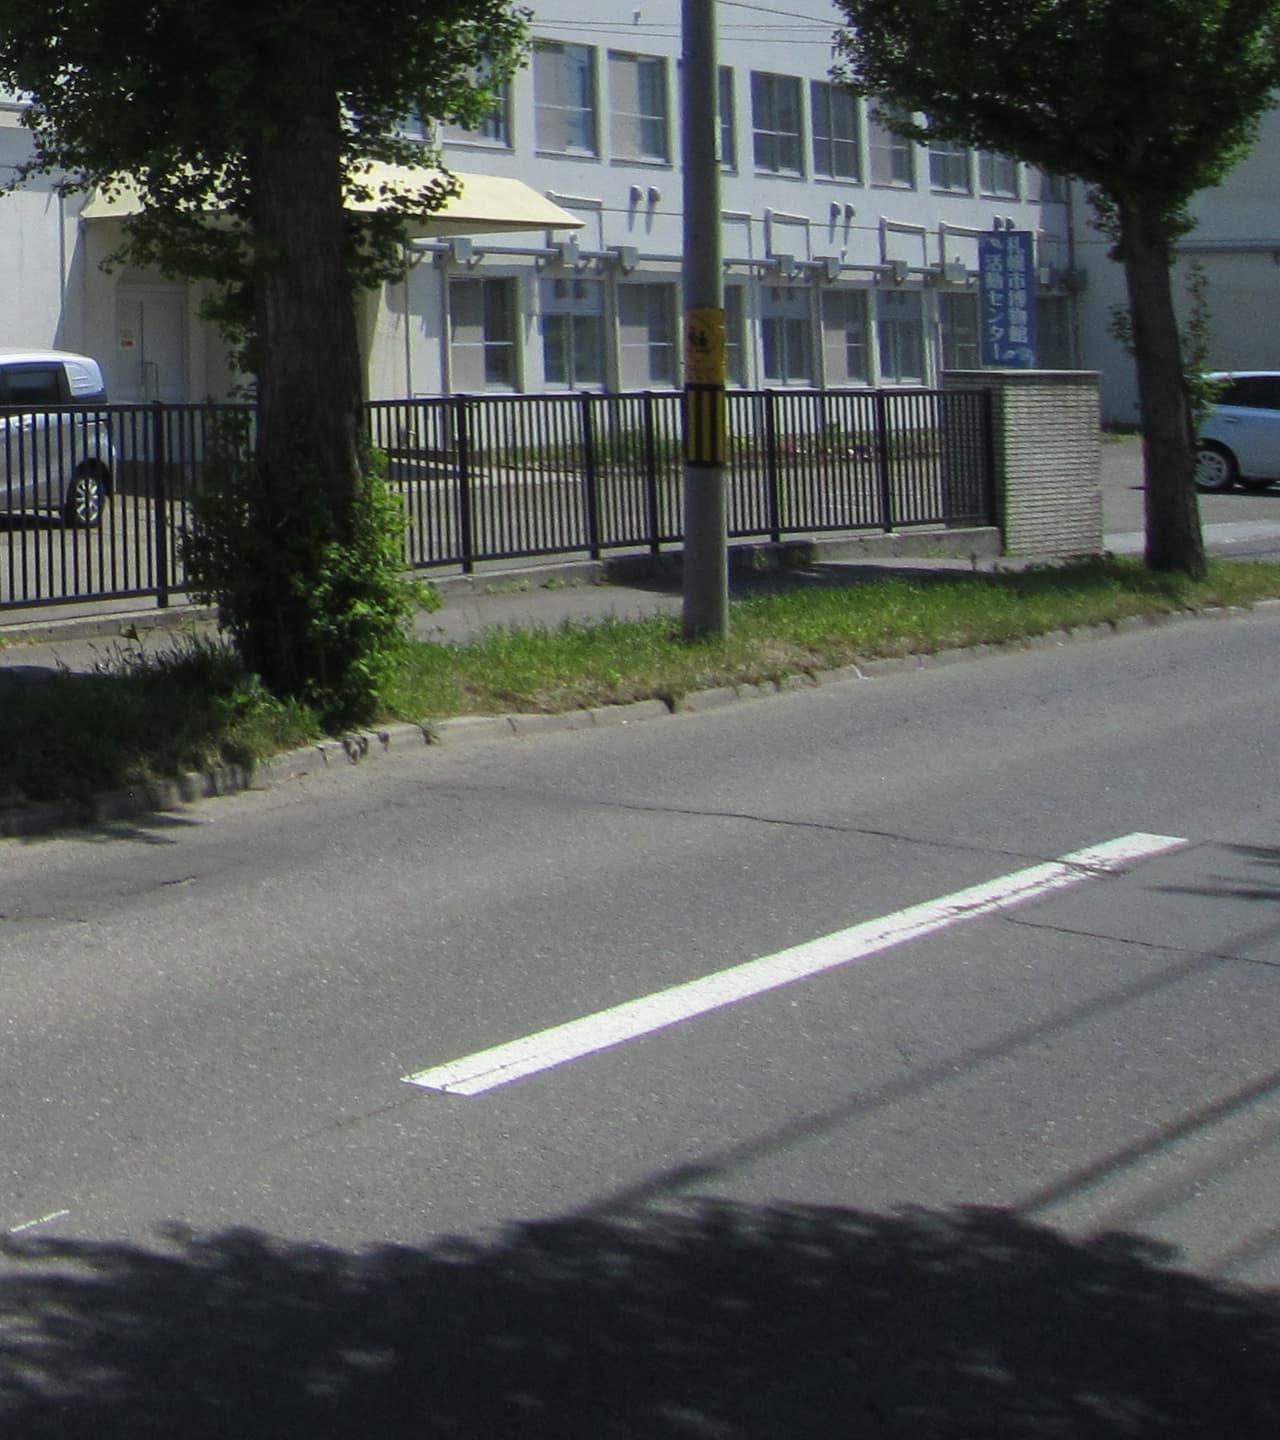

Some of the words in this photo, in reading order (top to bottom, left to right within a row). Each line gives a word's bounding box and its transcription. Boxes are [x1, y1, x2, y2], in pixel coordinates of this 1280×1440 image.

[984, 253, 1005, 361] 活動センター
[1006, 235, 1029, 344] 札幌市博物館
